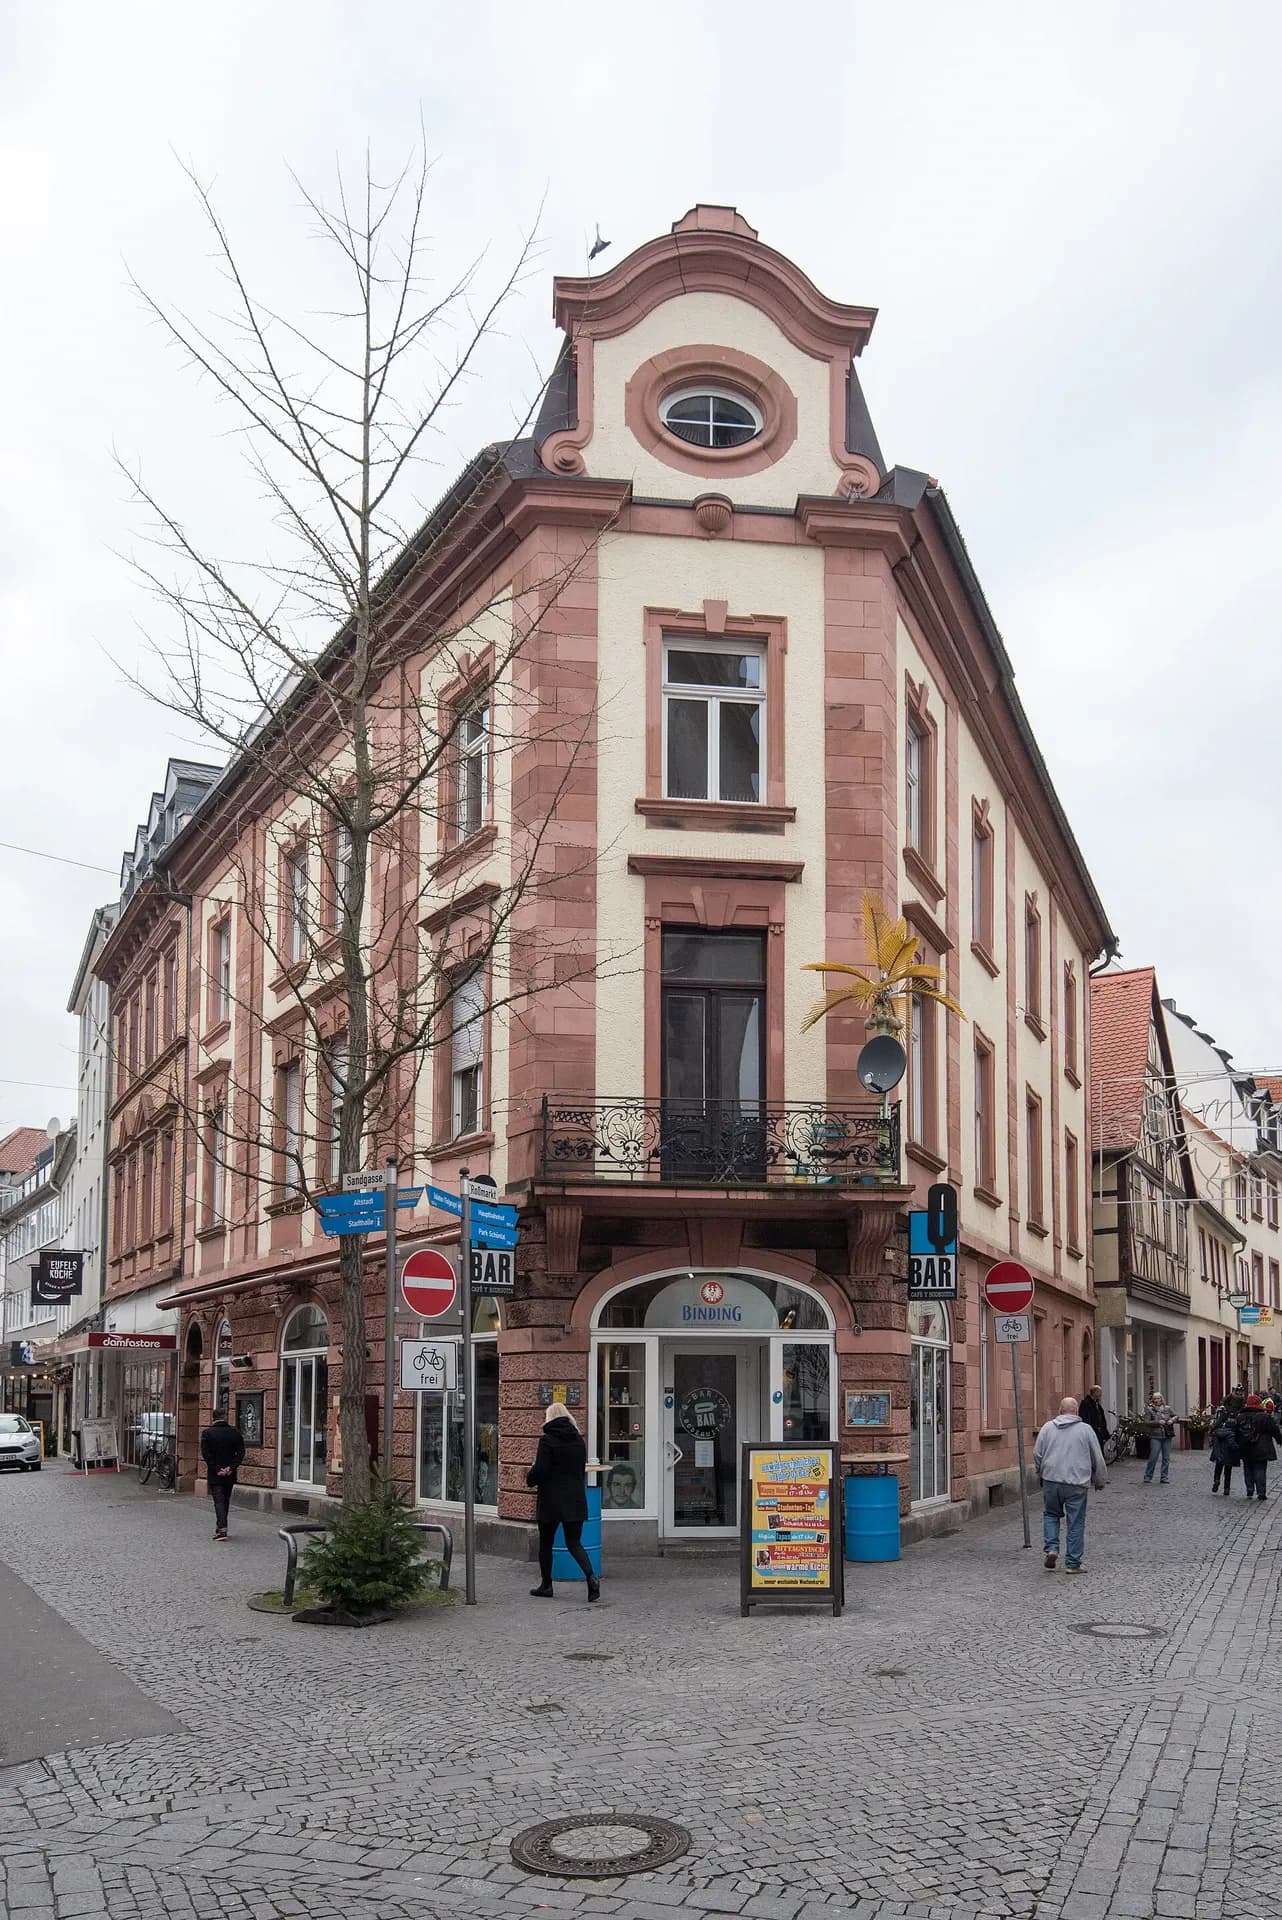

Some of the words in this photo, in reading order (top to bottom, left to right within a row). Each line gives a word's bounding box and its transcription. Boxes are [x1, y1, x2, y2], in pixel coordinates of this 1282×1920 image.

[347, 1173, 383, 1186] Sandgasse
[471, 1184, 497, 1200] Roßmarkt
[353, 1198, 374, 1206] Altstadt
[348, 1218, 374, 1228] Stadthalle
[48, 1260, 78, 1271] TEUFELS
[471, 1252, 511, 1283] BAR
[909, 1257, 952, 1288] BAR
[1007, 1331, 1019, 1339] frei
[102, 1337, 160, 1348] damfastore
[421, 1373, 438, 1384] frei
[696, 1413, 715, 1427] BAR
